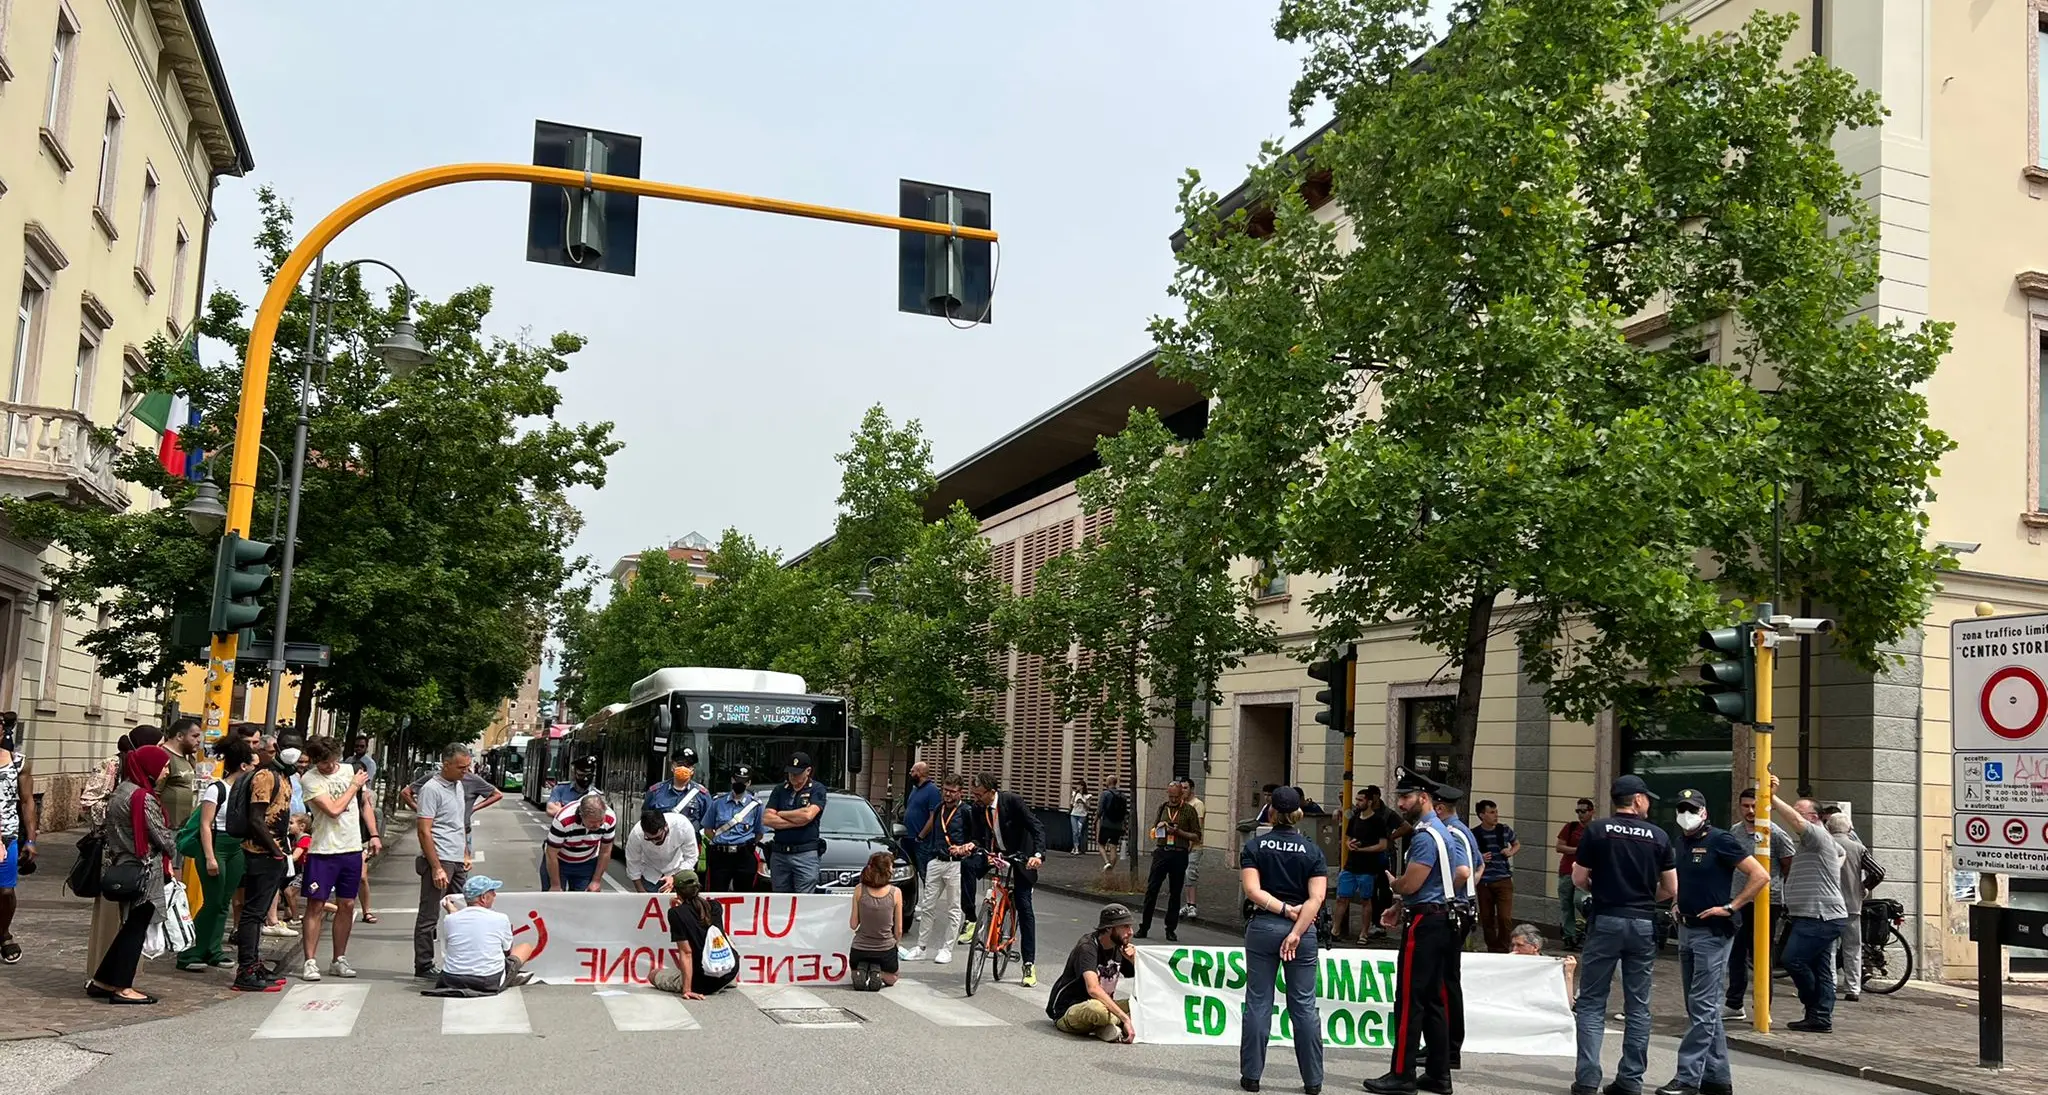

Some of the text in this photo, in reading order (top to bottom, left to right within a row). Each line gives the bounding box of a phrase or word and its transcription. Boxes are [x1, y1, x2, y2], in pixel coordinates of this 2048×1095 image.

[1962, 632, 1982, 641] zona
[1985, 626, 2022, 639] traffico
[700, 703, 714, 720] 3
[723, 705, 750, 713] MEANO
[754, 705, 761, 714] 2
[775, 706, 812, 715] GARDOLO
[717, 712, 750, 722] P.DANTE
[763, 714, 808, 724] VILLAZZANO
[1605, 824, 1654, 839] POLIZIA
[1971, 824, 1985, 836] 30
[1260, 840, 1307, 853] POLIZIA
[1976, 850, 2002, 859] varco
[1184, 995, 1227, 1037] ED
